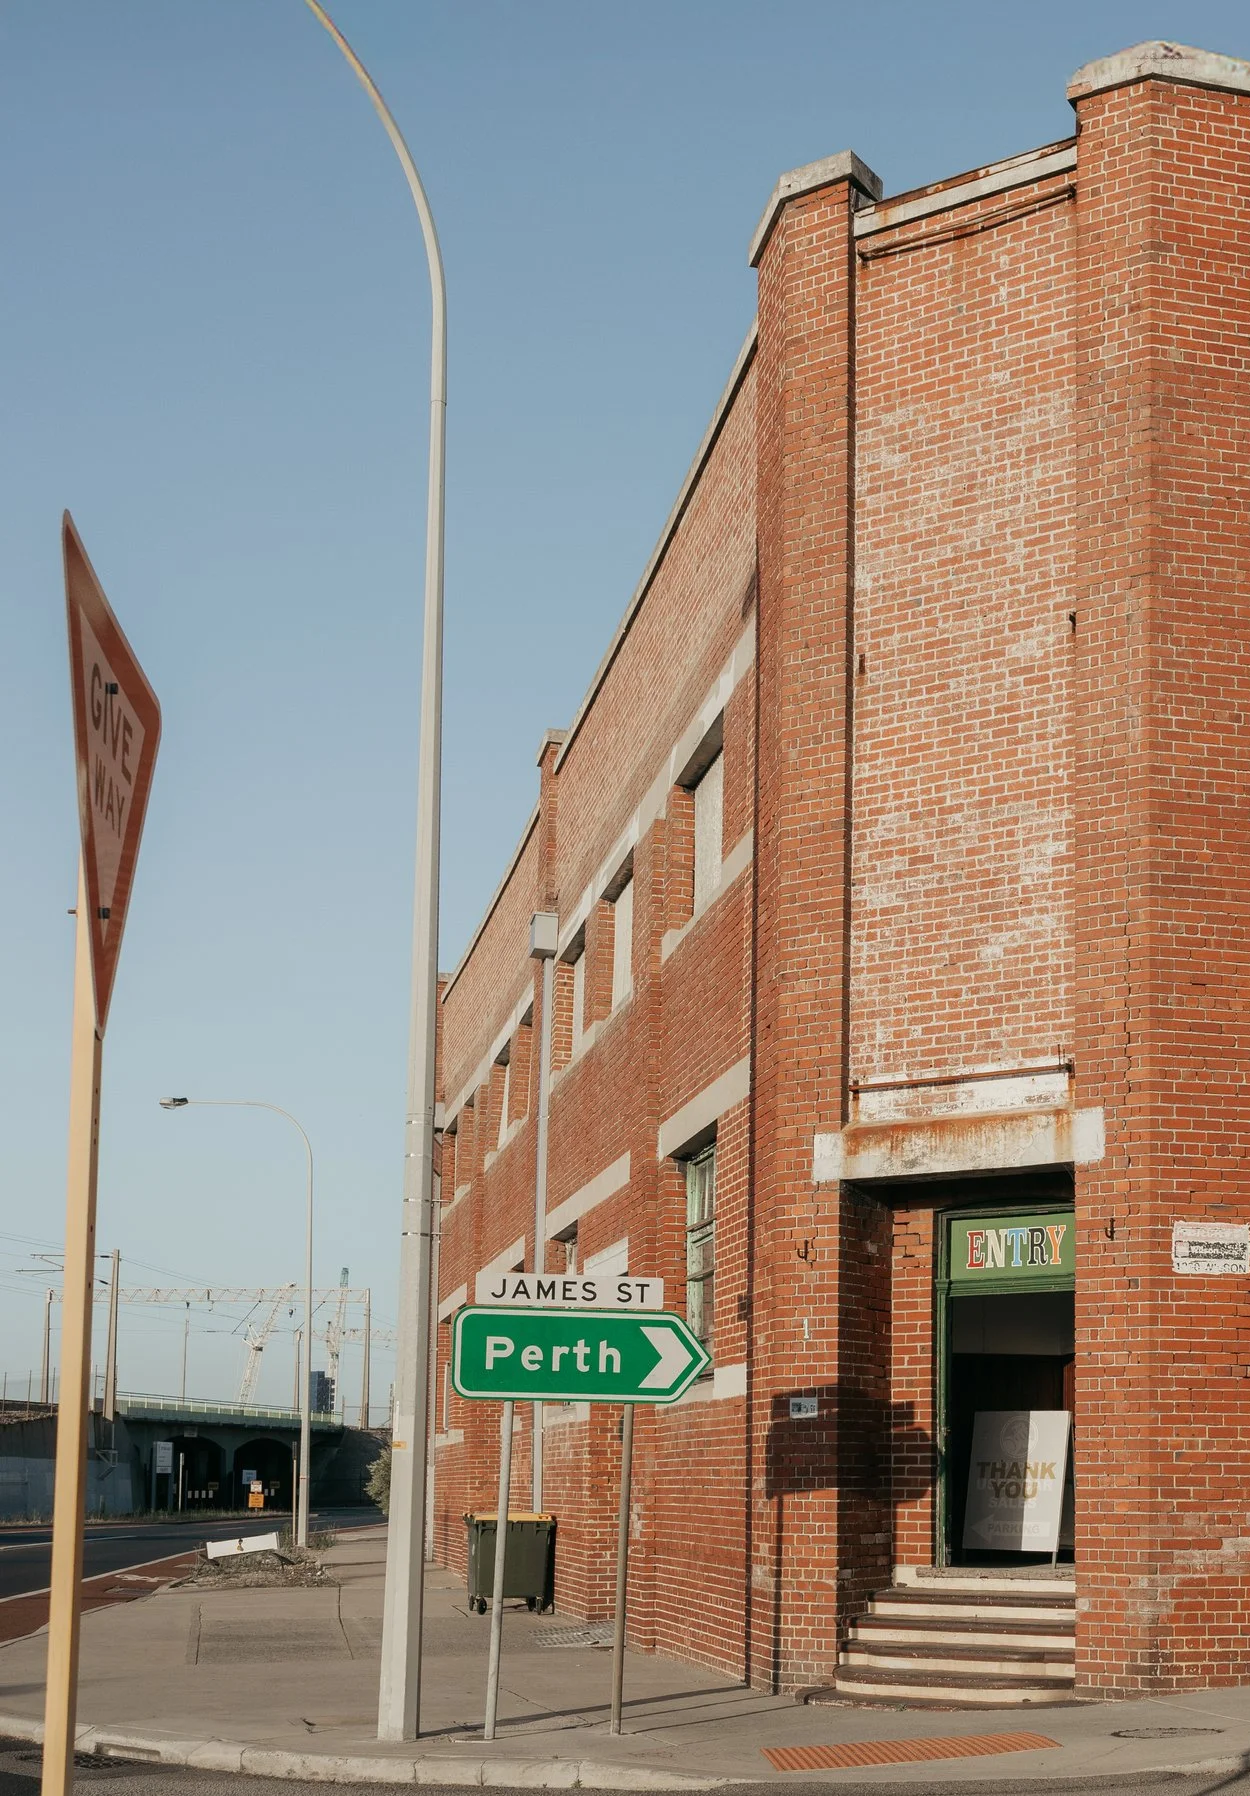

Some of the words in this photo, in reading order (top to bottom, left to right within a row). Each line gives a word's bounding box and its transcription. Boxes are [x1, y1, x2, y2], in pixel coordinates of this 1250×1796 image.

[91, 662, 133, 787] GIVE
[94, 753, 125, 839] WAY
[966, 1224, 1067, 1269] ENTRY
[490, 1278, 598, 1302] JAMES
[616, 1283, 651, 1304] ST
[484, 1335, 622, 1374] Perth
[976, 1461, 1057, 1479] THANK
[991, 1481, 1039, 1499] YOU
